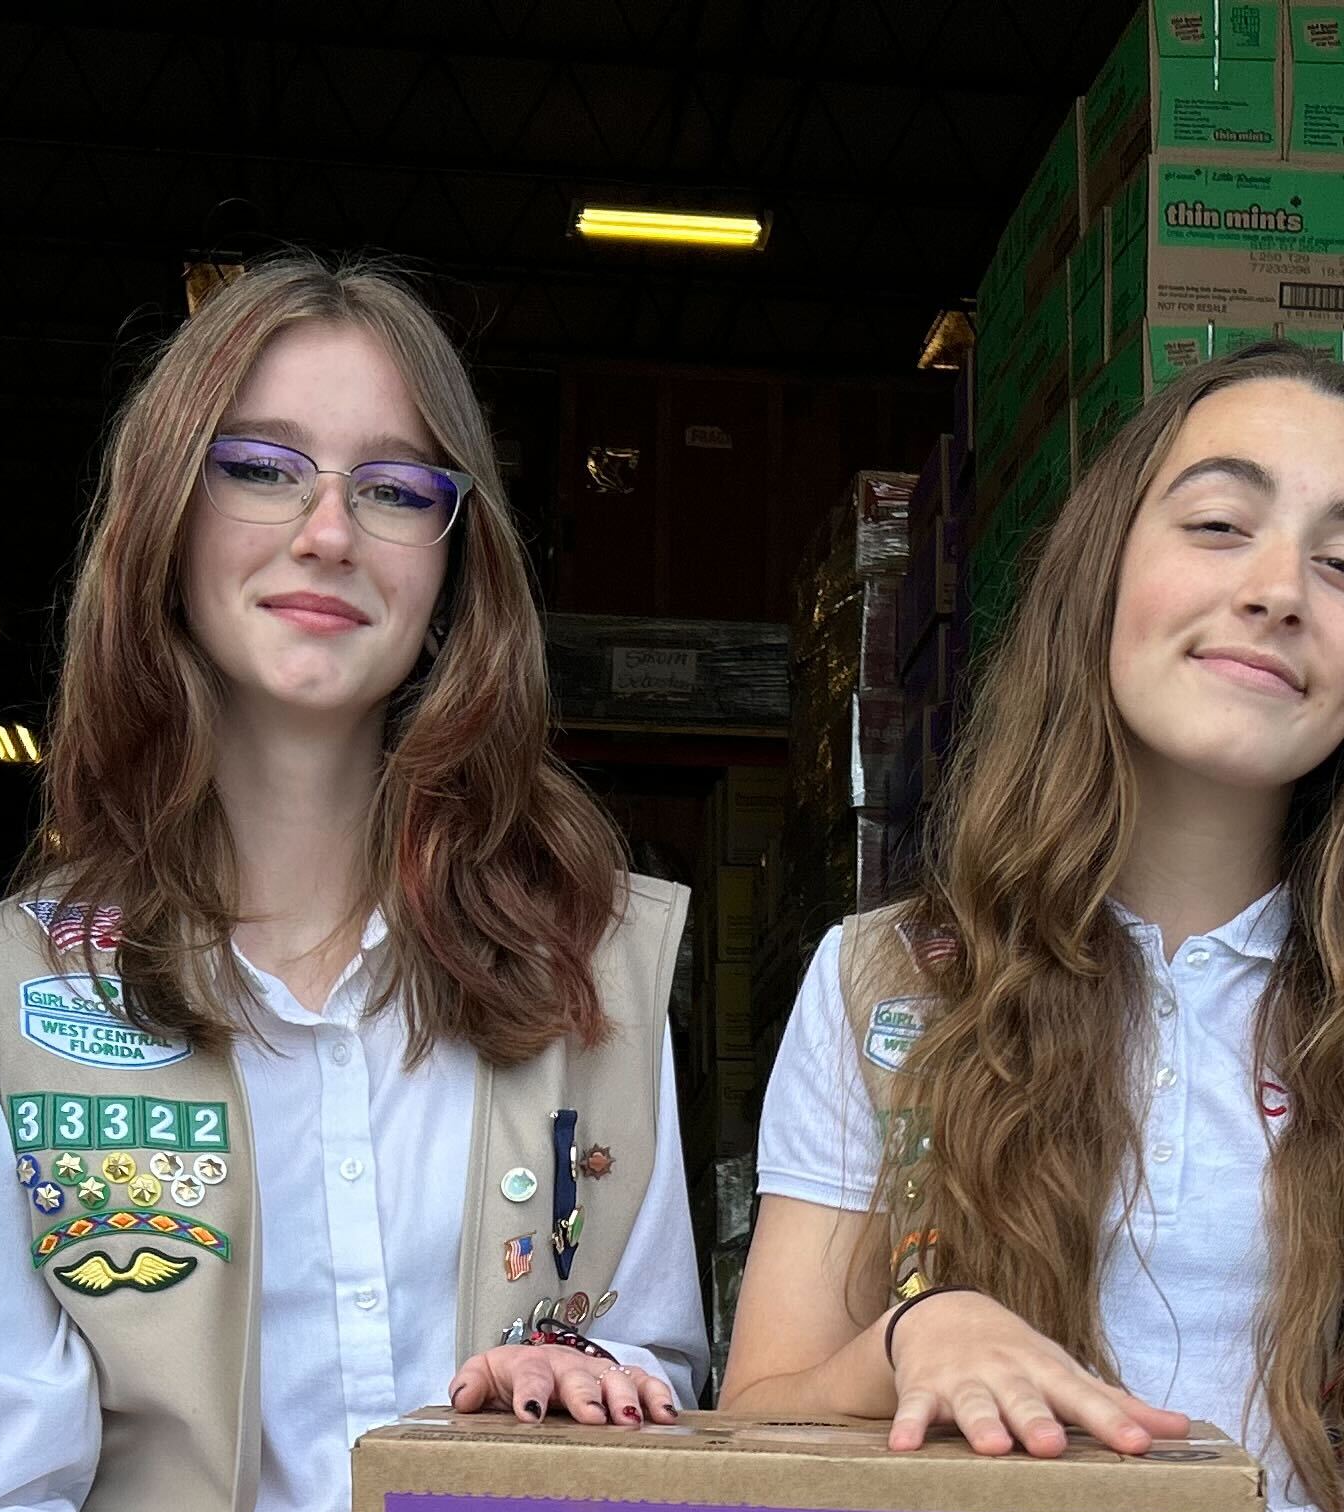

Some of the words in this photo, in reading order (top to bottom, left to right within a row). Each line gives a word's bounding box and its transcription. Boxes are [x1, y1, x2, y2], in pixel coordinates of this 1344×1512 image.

[1213, 130, 1237, 142] thin
[1237, 130, 1272, 143] mints
[1165, 202, 1221, 229] thin
[1224, 205, 1302, 233] mints
[29, 991, 69, 1008] GIRL
[41, 1020, 88, 1039] WEST
[92, 1028, 173, 1049] CENTRAL
[69, 1040, 146, 1060] FLORIDA
[17, 1101, 221, 1142] 33322
